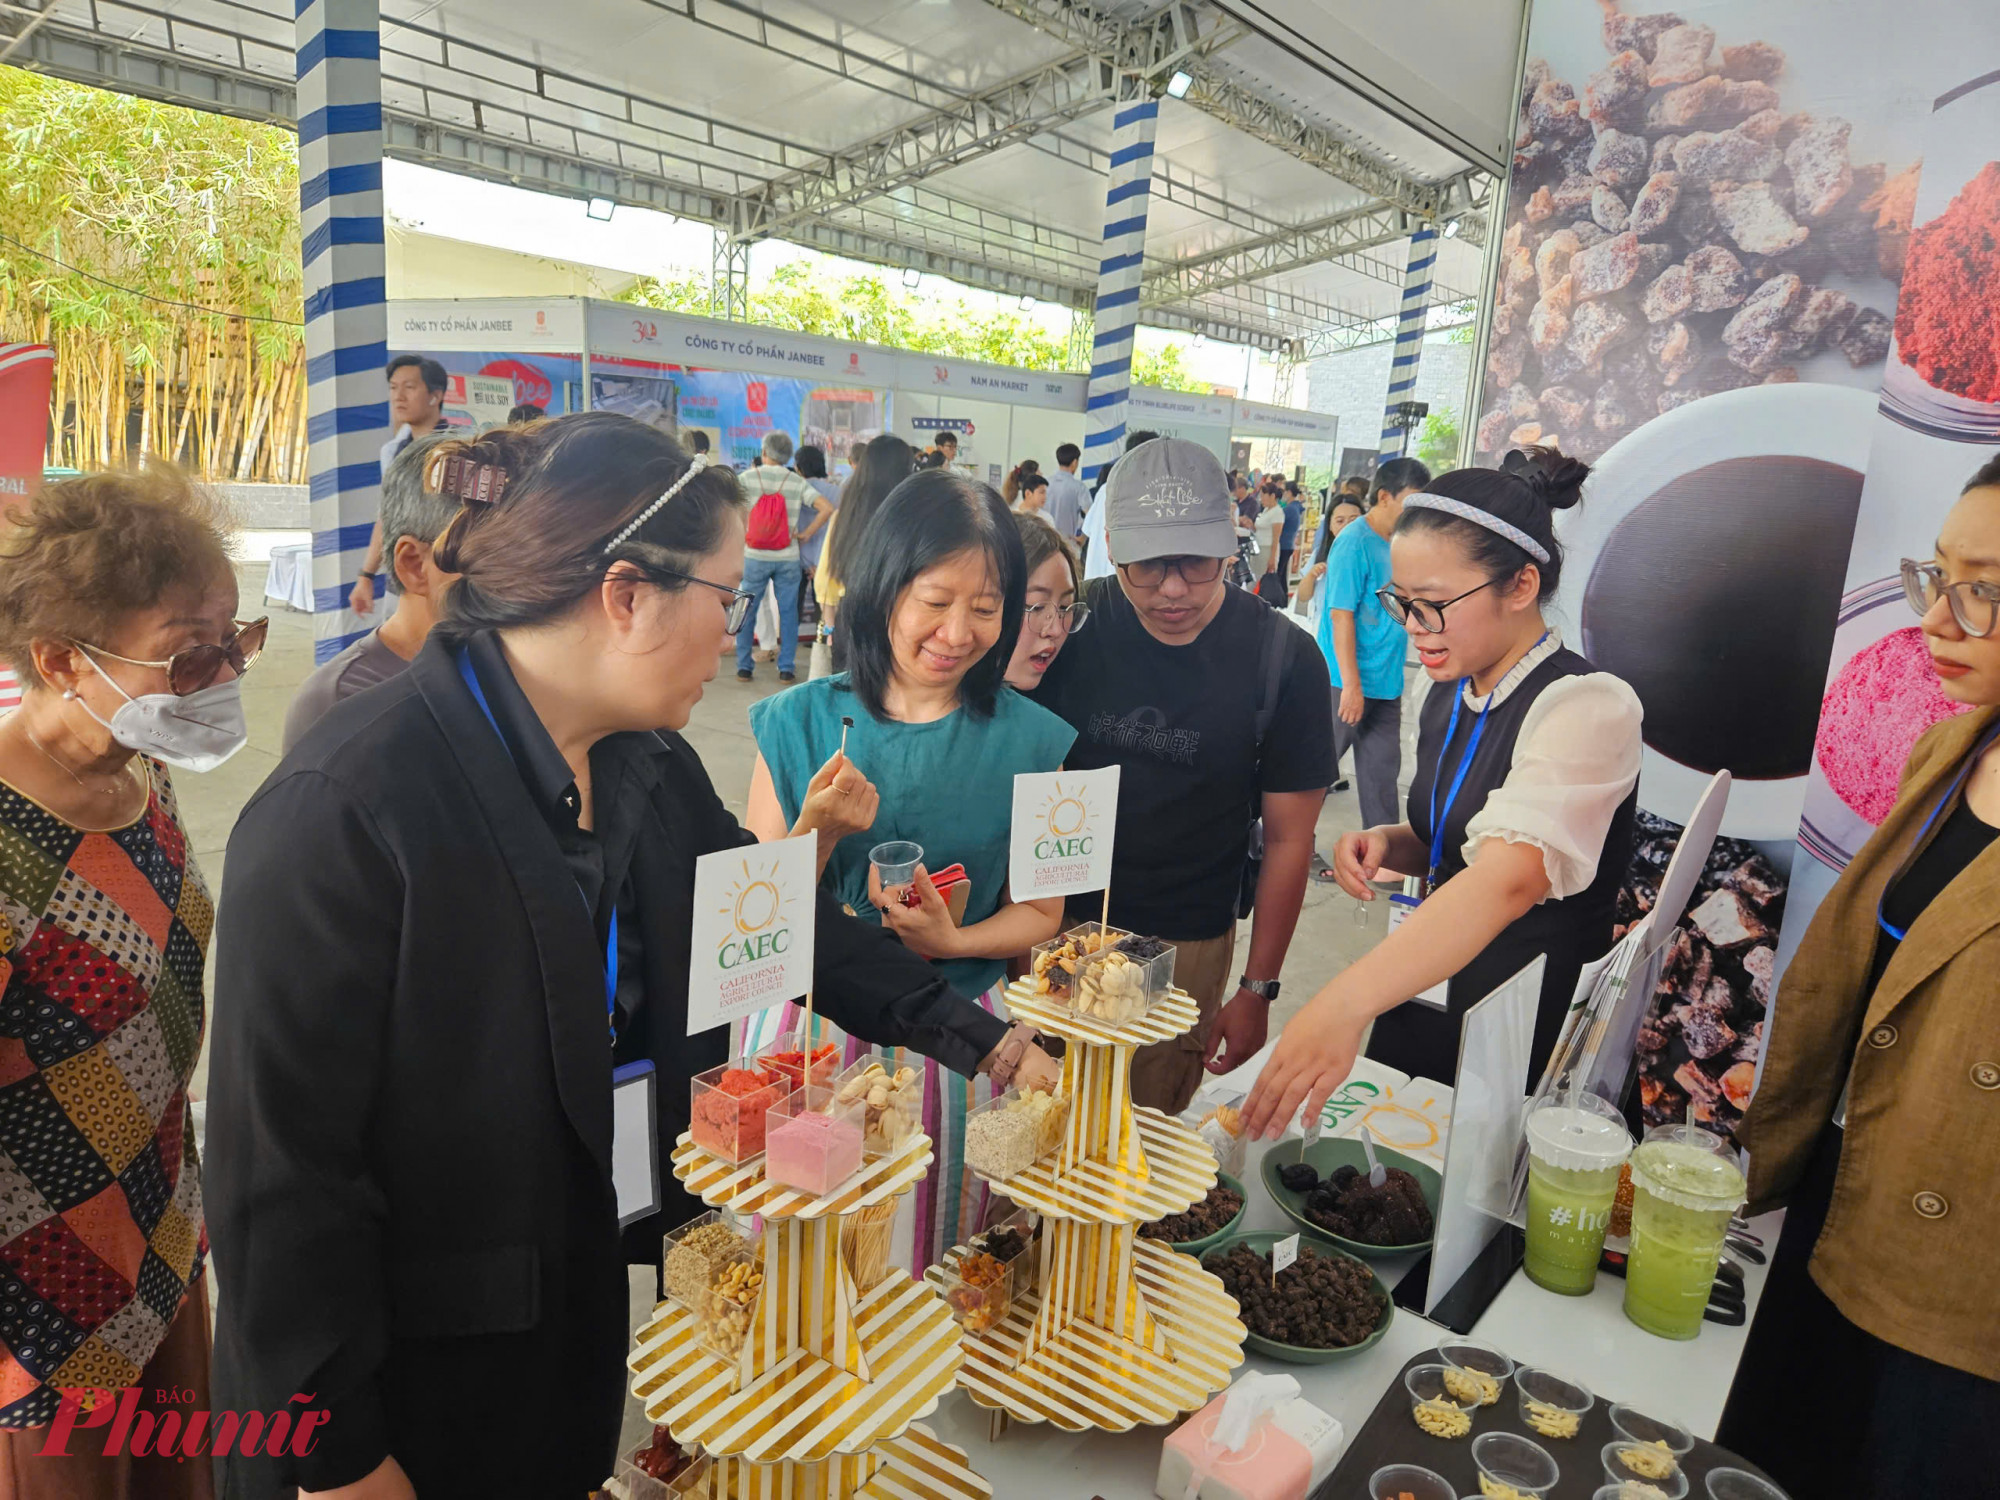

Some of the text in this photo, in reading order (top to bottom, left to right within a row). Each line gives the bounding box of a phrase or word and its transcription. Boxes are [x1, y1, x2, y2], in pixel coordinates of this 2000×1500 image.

[404, 318, 427, 332] CÔNG
[429, 320, 439, 332] TY
[479, 320, 513, 332] JANBEE
[685, 334, 718, 350] CÔNG
[721, 341, 735, 353] TY
[787, 351, 825, 366] JANBEE
[971, 376, 1028, 392] NAM AN MARKET
[1034, 836, 1093, 860] CAEC
[1034, 863, 1090, 875] CALIFORNIA
[1034, 879, 1059, 888] EXPORT
[718, 928, 789, 970] CAEC
[719, 964, 785, 991] CALIFORNIA
[719, 973, 784, 1000] AGRICULTURAL
[719, 981, 783, 1008] EXPORT COUNCIL
[1322, 1080, 1380, 1129] CAEC
